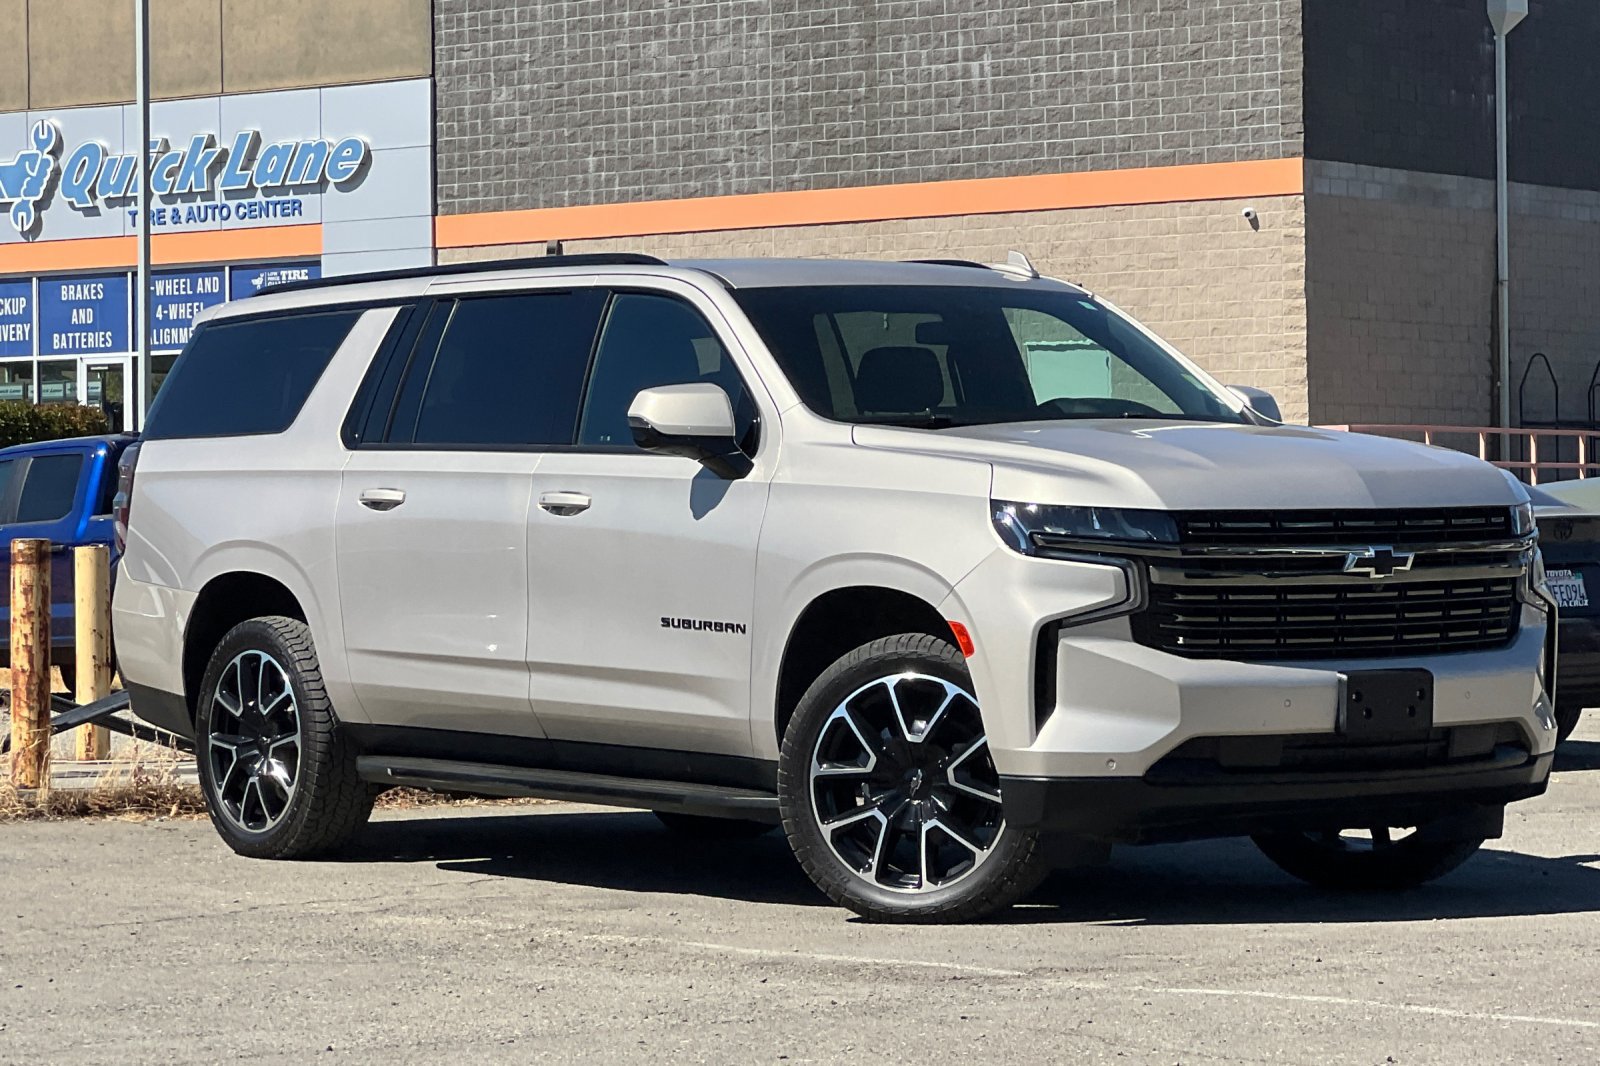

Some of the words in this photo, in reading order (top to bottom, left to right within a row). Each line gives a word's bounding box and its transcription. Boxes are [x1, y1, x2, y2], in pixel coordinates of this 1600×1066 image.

[220, 130, 365, 190] Lane
[171, 206, 182, 224] &
[185, 203, 231, 223] AUTO
[235, 199, 303, 220] CENTER
[280, 269, 309, 281] TIRE
[61, 283, 104, 301] BRAKES
[196, 276, 220, 294] AND
[71, 308, 93, 325] AND
[53, 331, 112, 350] BATTERIES
[660, 617, 746, 634] SUBURBAN
